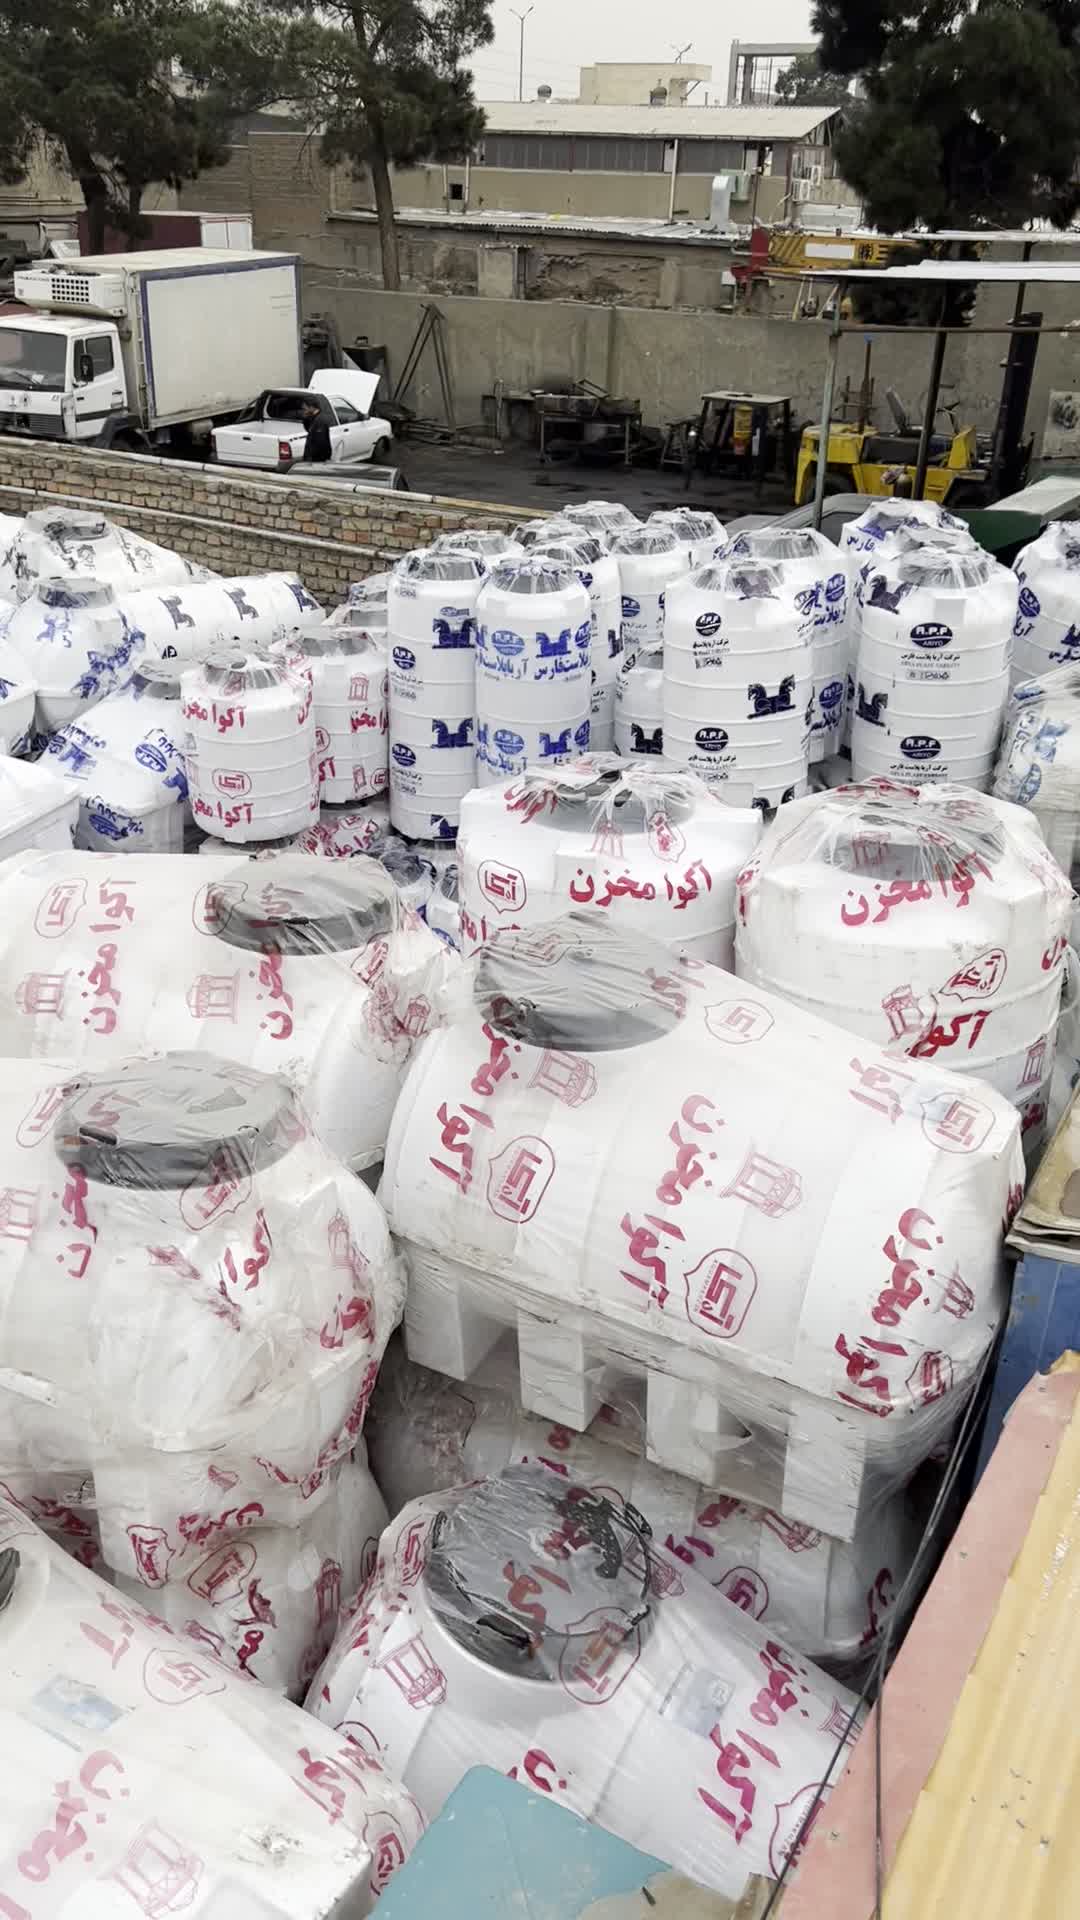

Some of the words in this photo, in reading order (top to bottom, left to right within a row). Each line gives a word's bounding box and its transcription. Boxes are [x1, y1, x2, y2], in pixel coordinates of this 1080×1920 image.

[211, 703, 247, 734] آکوا
[217, 800, 254, 828] آکوا
[88, 877, 137, 934] آکوا
[569, 868, 656, 908] مخزن
[664, 859, 713, 909] آکوا
[840, 880, 932, 926] مخزن
[934, 851, 994, 908] آکوا
[77, 943, 122, 1035] مخزن
[249, 943, 294, 1041] مخزن
[429, 1102, 495, 1194] آکوا
[51, 1161, 99, 1279] مخزن
[618, 1211, 687, 1310] آکوا
[655, 1093, 727, 1206] مخزن
[871, 1206, 945, 1328] مخزن
[834, 1332, 909, 1419] آکوا
[16, 1748, 131, 1883] مخزن
[697, 1722, 782, 1846] آکوا
